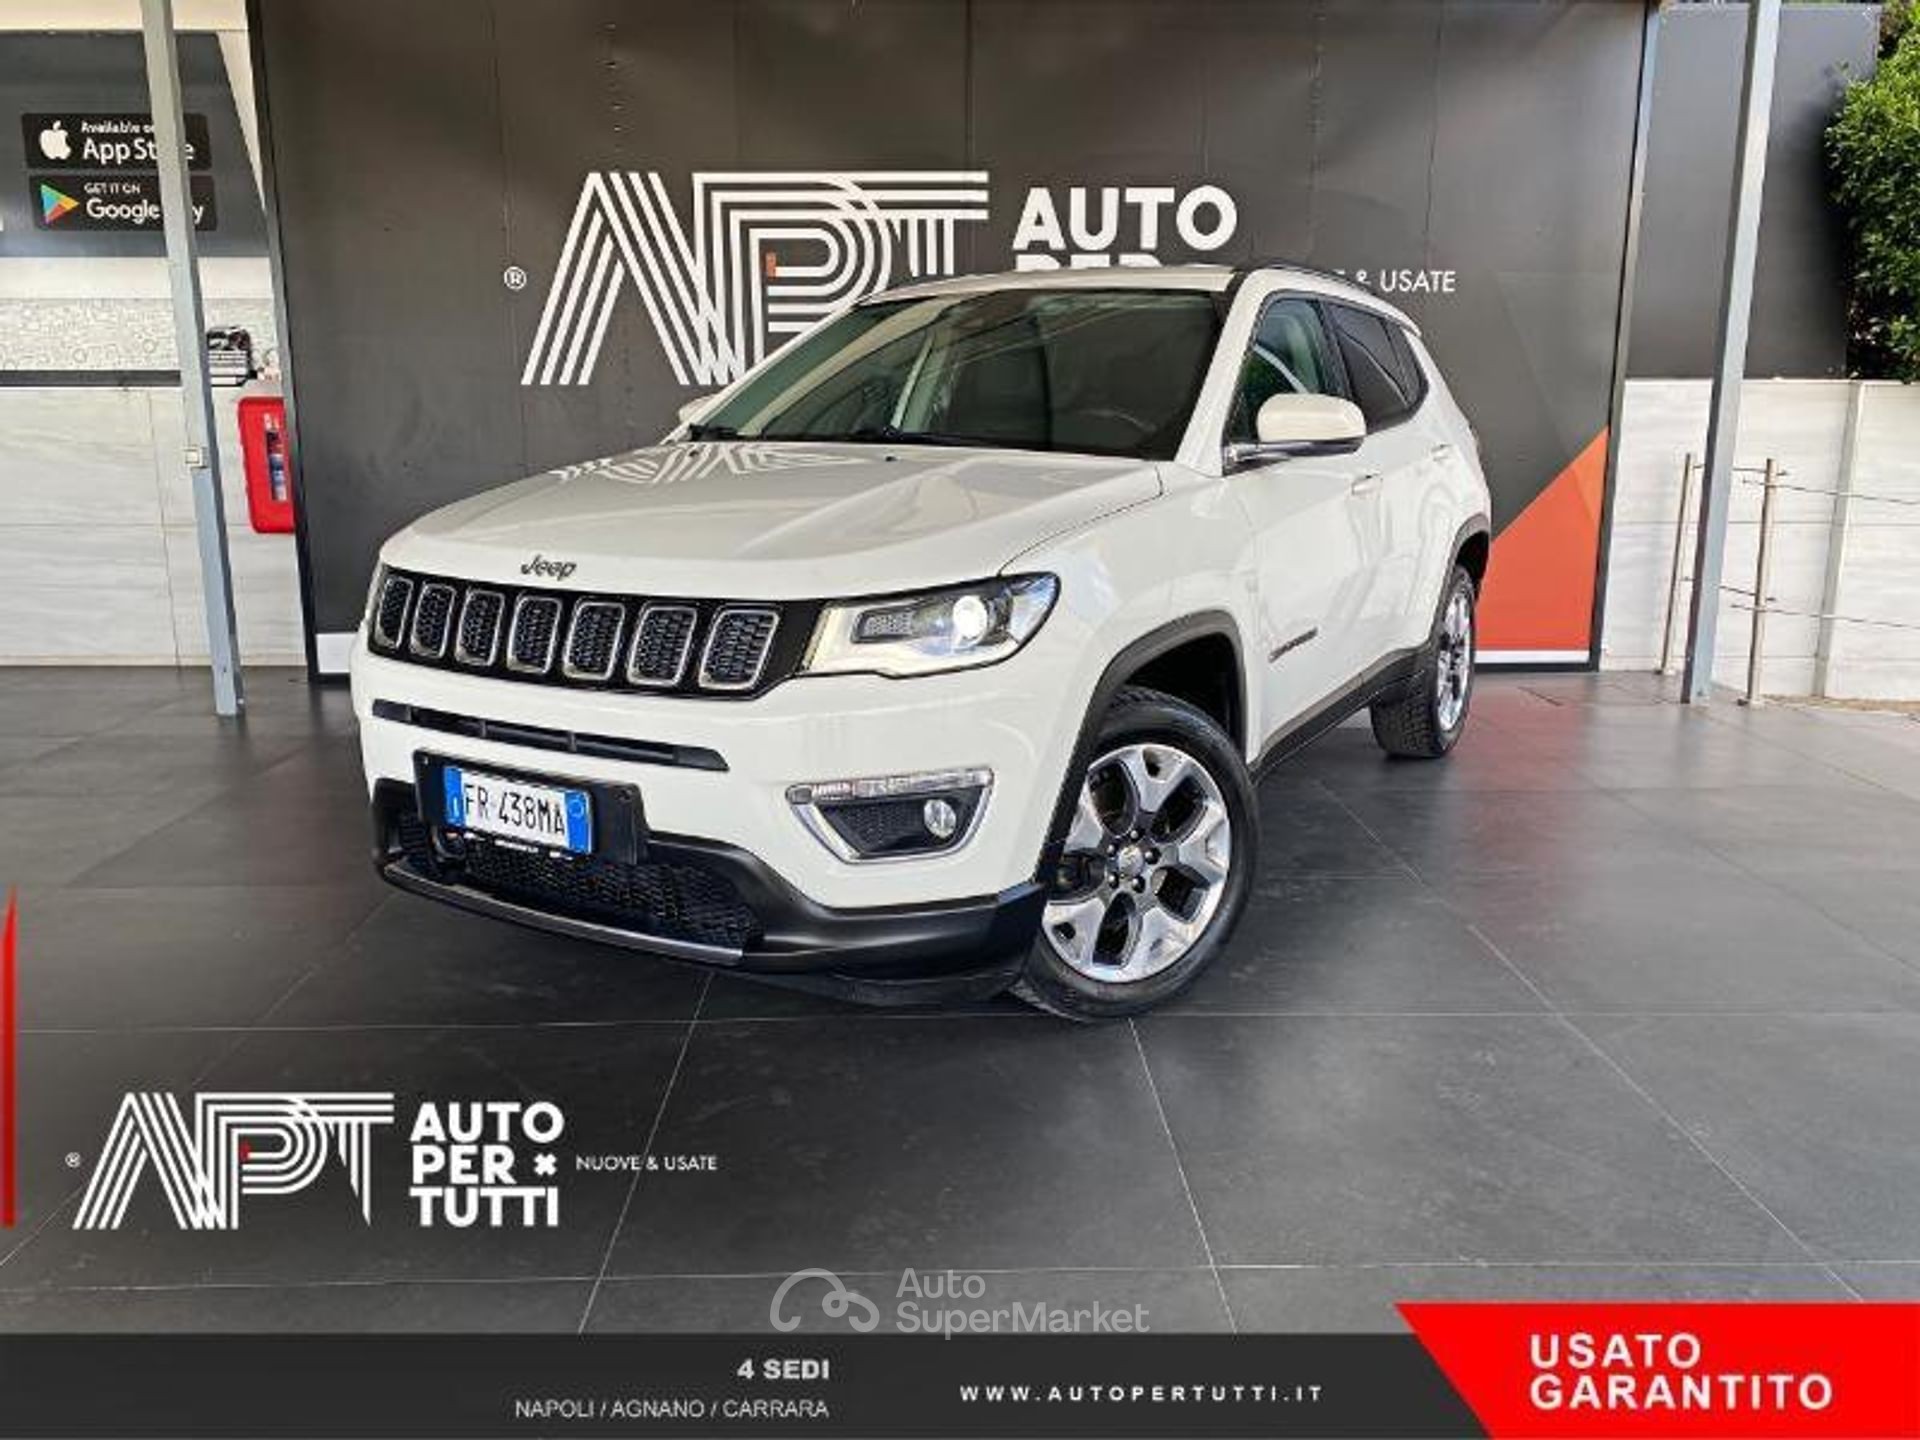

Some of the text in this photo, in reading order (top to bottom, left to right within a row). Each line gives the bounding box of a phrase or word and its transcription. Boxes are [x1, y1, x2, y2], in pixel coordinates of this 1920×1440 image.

[81, 121, 140, 133] Available
[83, 137, 194, 165] App Ste
[84, 182, 107, 194] GET
[86, 197, 160, 224] Google
[1011, 185, 1238, 251] AUTO
[1379, 268, 1456, 293] USATE
[520, 554, 577, 581] Jeep
[464, 783, 489, 821] FR
[499, 791, 565, 835] 438MA
